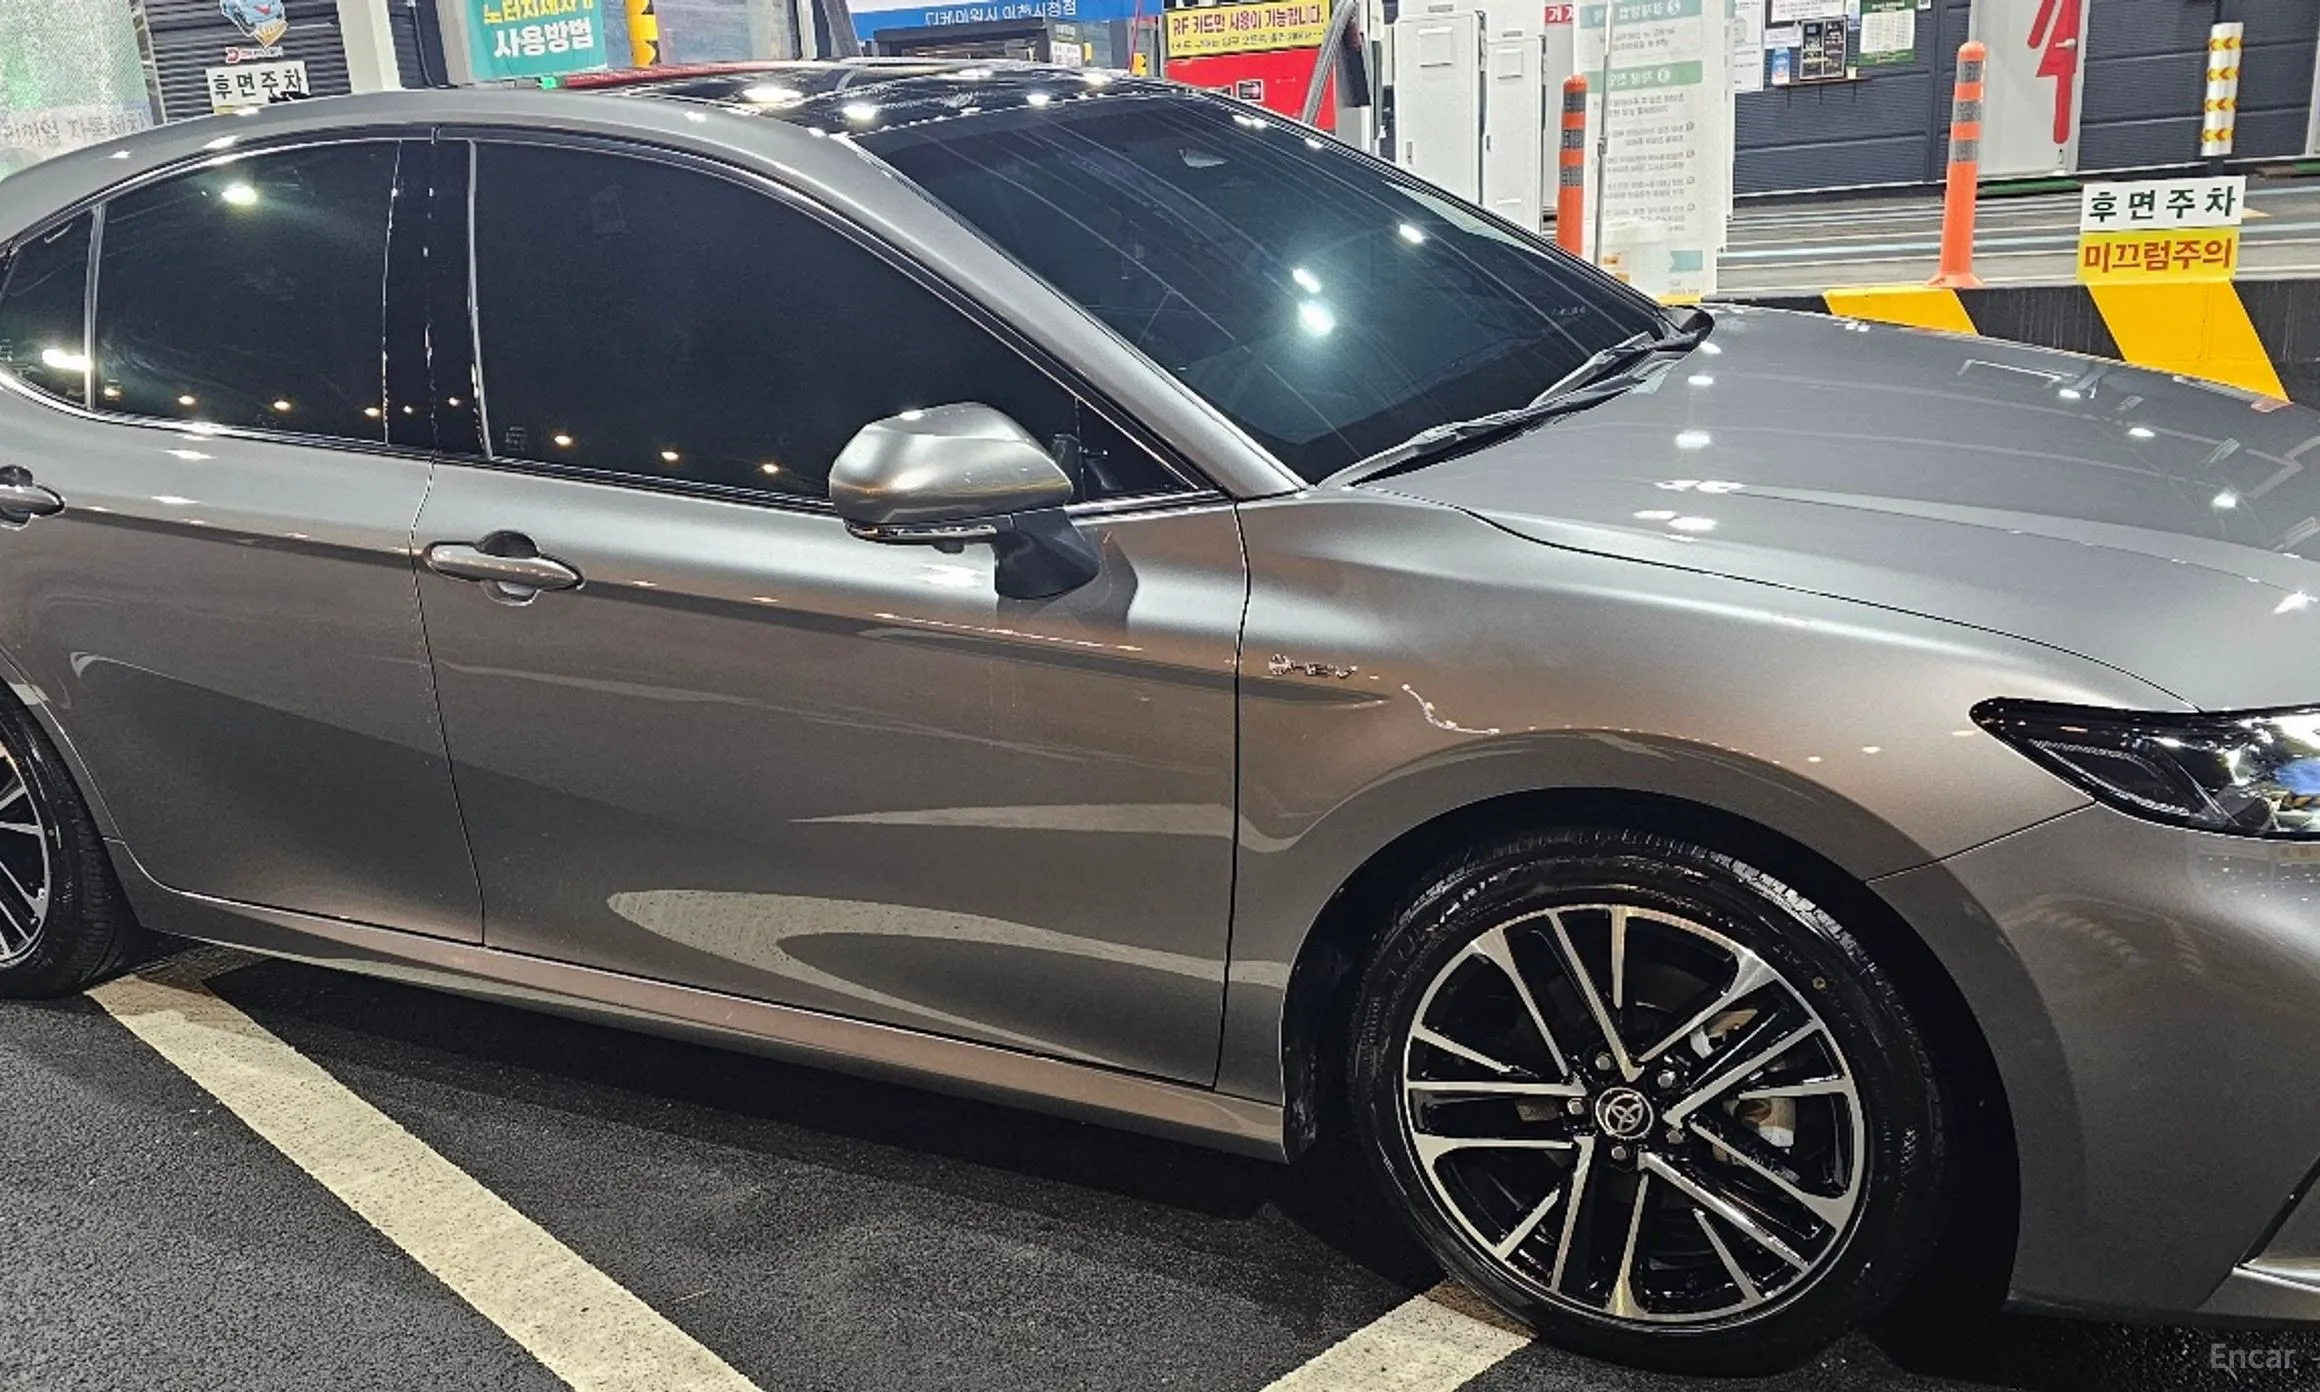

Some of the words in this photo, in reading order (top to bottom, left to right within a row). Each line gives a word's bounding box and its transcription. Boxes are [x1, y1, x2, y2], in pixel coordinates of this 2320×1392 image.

[494, 17, 594, 57] 사용방법
[1173, 17, 1189, 36] RF
[213, 68, 302, 100] 후면주차
[2088, 186, 2236, 223] 후면주차
[2084, 238, 2232, 273] 미끄럼주의
